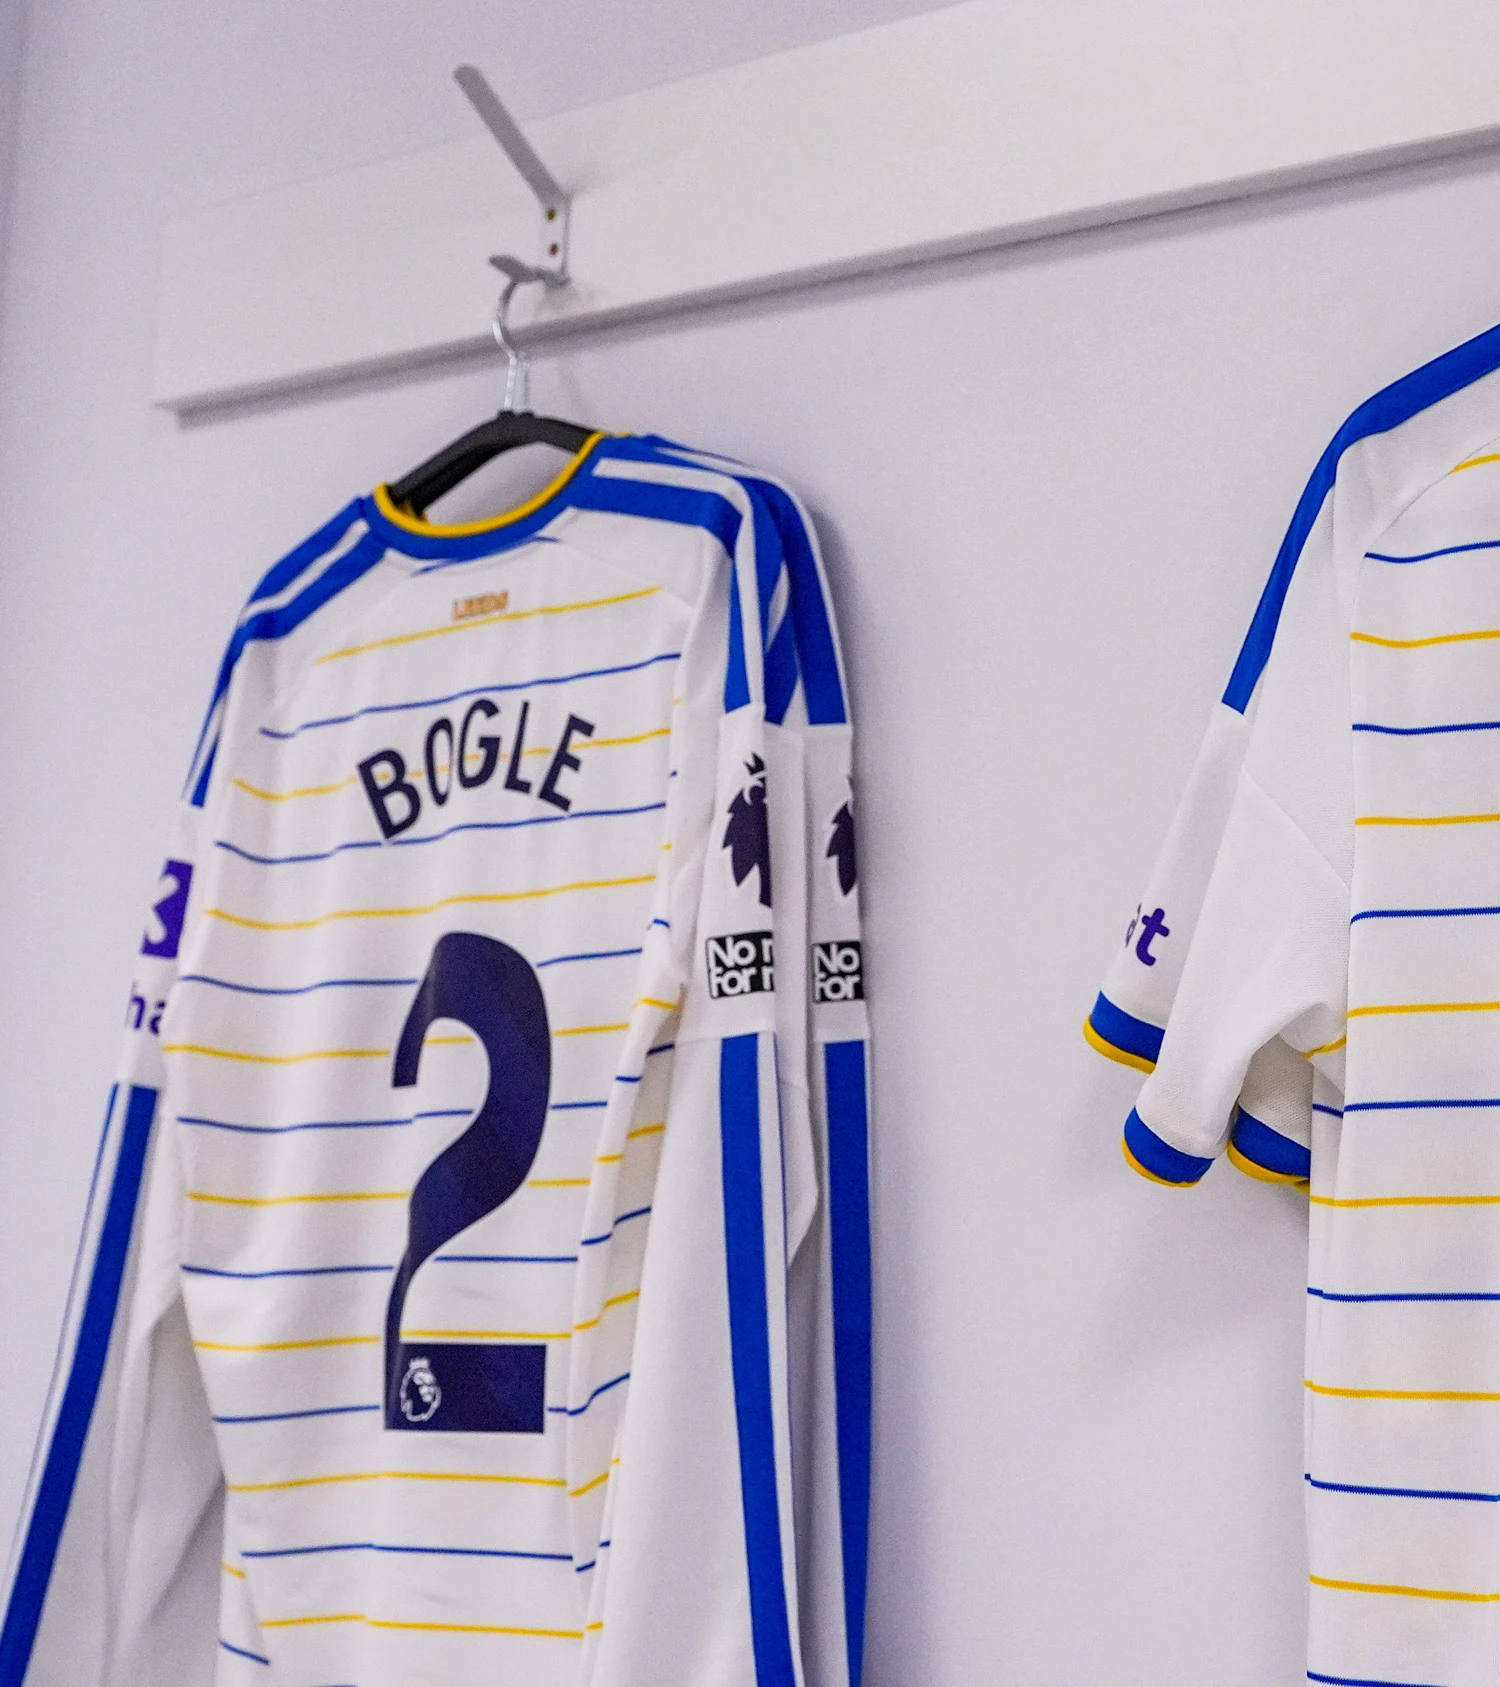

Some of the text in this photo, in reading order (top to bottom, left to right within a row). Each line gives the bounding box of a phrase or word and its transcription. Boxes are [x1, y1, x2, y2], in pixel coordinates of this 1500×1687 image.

[357, 698, 595, 840] BOGLE
[707, 936, 757, 968] No
[814, 943, 860, 974] No
[384, 931, 552, 1434] 2
